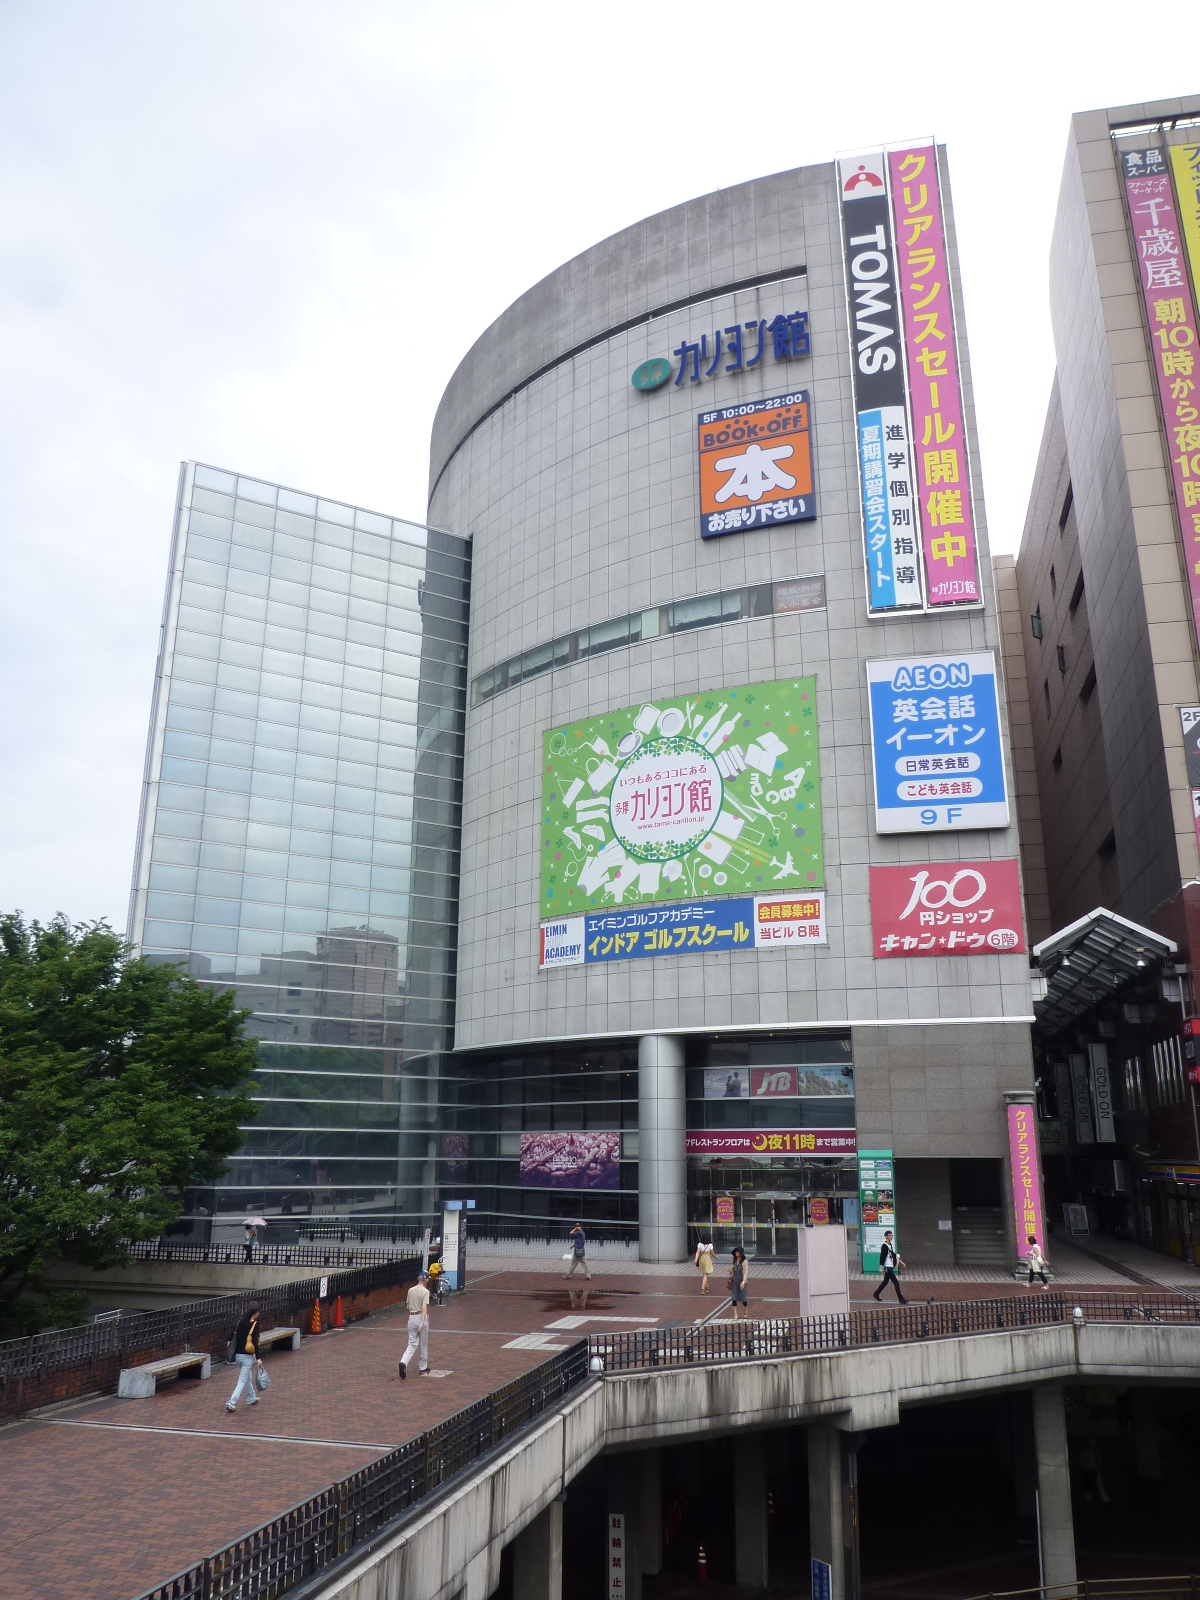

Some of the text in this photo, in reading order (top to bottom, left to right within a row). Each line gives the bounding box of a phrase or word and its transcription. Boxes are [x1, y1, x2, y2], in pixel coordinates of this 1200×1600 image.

[1125, 150, 1162, 167] 食品
[1127, 164, 1165, 177] スーパー
[1127, 178, 1168, 189] ファーマーズ
[1131, 185, 1165, 195] マーケット
[1134, 197, 1184, 290] 千歳屋
[849, 225, 896, 375] TOMAS
[673, 311, 811, 387] カリヨン館
[898, 154, 967, 568] クリアランスセール開催中
[703, 412, 718, 424] 5F
[714, 444, 797, 504] 本
[708, 498, 806, 532] お売り下さい
[861, 424, 891, 588] 夏期講習会スタート
[885, 425, 916, 584] 進学個別指導
[938, 580, 976, 595] カリヨン館
[895, 664, 968, 687] AEON
[892, 694, 976, 723] 英会話
[886, 723, 986, 751] イーオン
[620, 764, 707, 787] いつもあるココにある
[906, 757, 970, 772] 日常英会話
[615, 778, 712, 822] 多摩 カリヨン館
[907, 781, 973, 797] こども英会話
[899, 868, 987, 921] 100
[588, 906, 715, 932] エイミンゴルフアカデミー
[759, 902, 819, 920] 会員募集中!
[919, 908, 994, 926] 円ショップ
[545, 923, 568, 938] EIMIN
[588, 921, 750, 956] インドア ゴルフスクール
[760, 925, 820, 940] 当ビル 8階
[990, 933, 1016, 947] 6階
[545, 944, 582, 959] ACADEMY
[757, 1071, 792, 1095] JTB
[1096, 1067, 1110, 1119] GOLD ON
[1076, 1075, 1089, 1123] GOLD ON
[768, 1133, 816, 1150] 夜11時
[611, 1517, 622, 1588] 駐輪禁止
